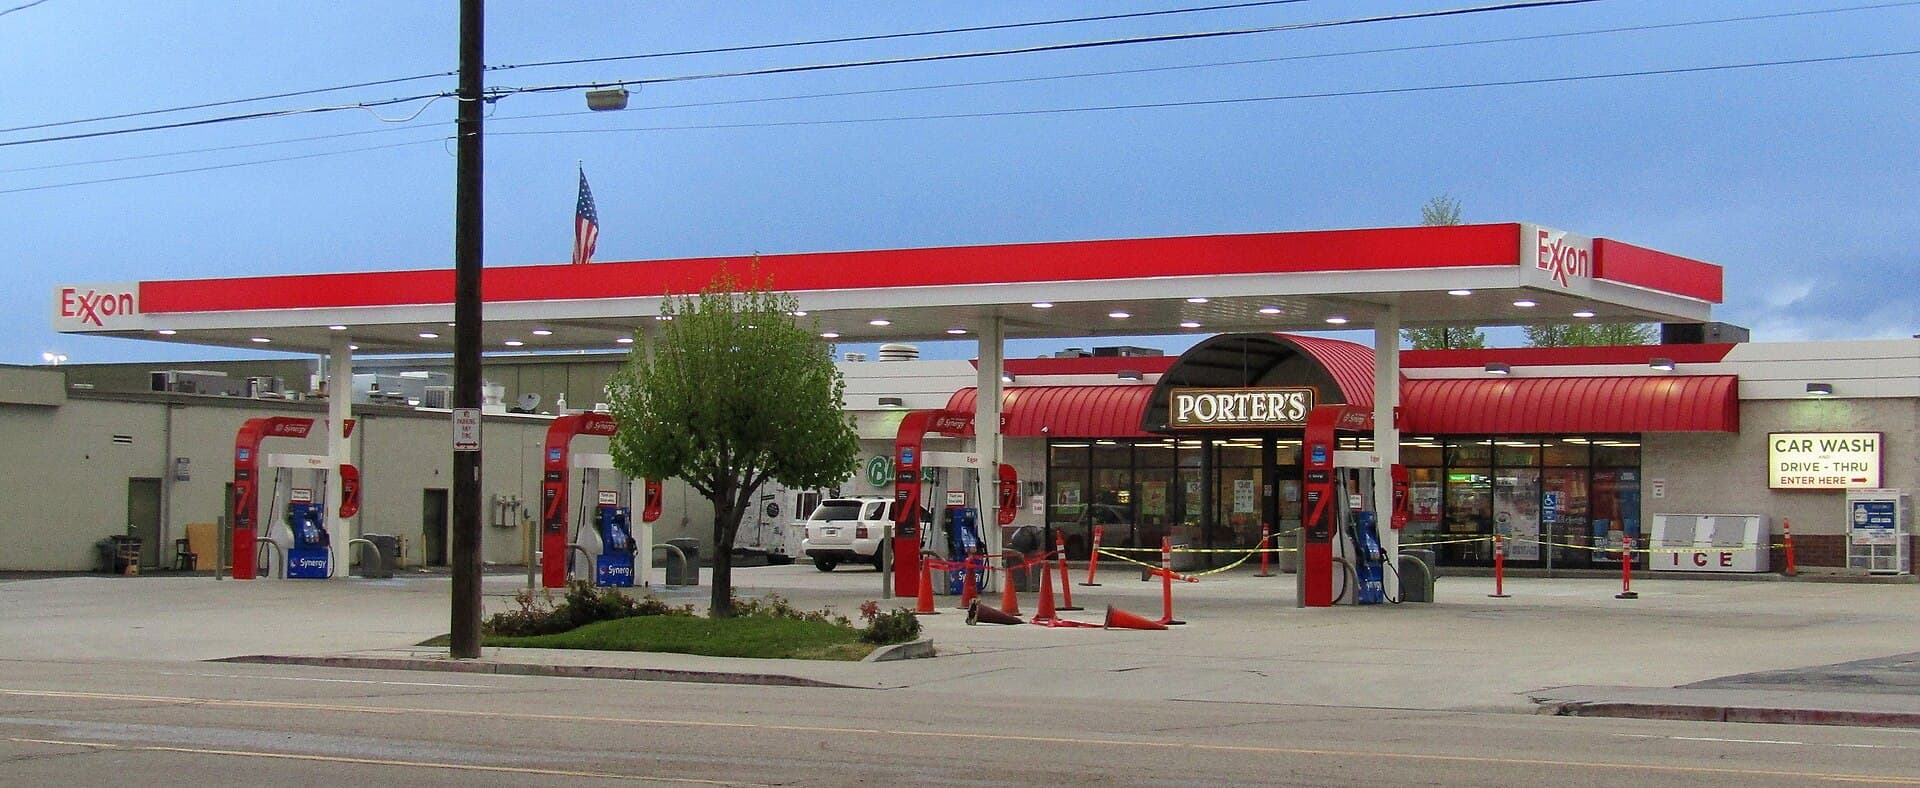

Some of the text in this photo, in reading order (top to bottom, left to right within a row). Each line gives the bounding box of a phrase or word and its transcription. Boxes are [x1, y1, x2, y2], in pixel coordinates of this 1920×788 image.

[1537, 230, 1588, 289] Exxon
[61, 288, 134, 327] Exxon
[1176, 391, 1307, 423] PORTER'S
[594, 421, 617, 431] Synergy
[944, 419, 966, 430] Synergy
[1000, 417, 1006, 425] 3
[283, 424, 307, 434] Synergy
[1775, 439, 1874, 453] CAR WASH
[1780, 462, 1820, 472] DRIVE
[1832, 462, 1869, 472] THRU
[1780, 476, 1847, 485] ENTER HERE
[300, 557, 327, 572] Synergy
[1673, 551, 1733, 567] ICE
